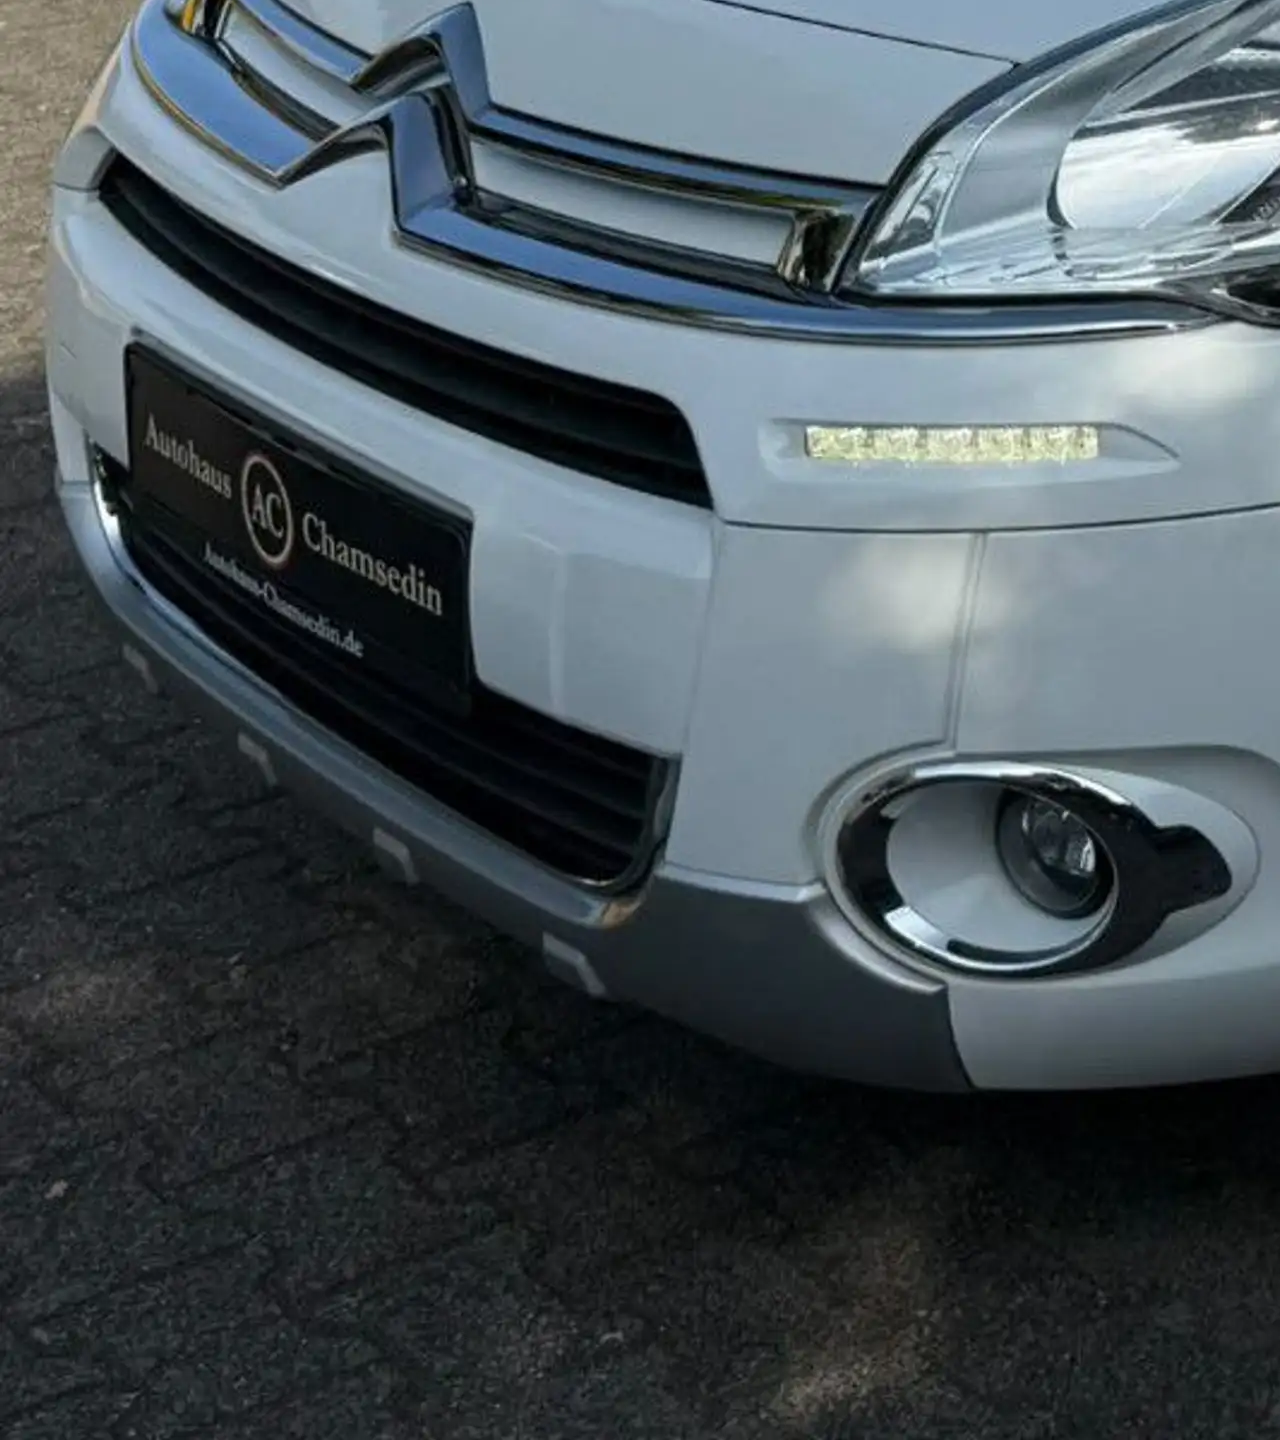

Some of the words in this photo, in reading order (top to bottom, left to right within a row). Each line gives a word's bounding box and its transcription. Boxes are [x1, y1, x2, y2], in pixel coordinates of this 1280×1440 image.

[142, 412, 232, 500] Autohaus
[252, 483, 285, 539] AC
[302, 512, 443, 616] Chamsedin
